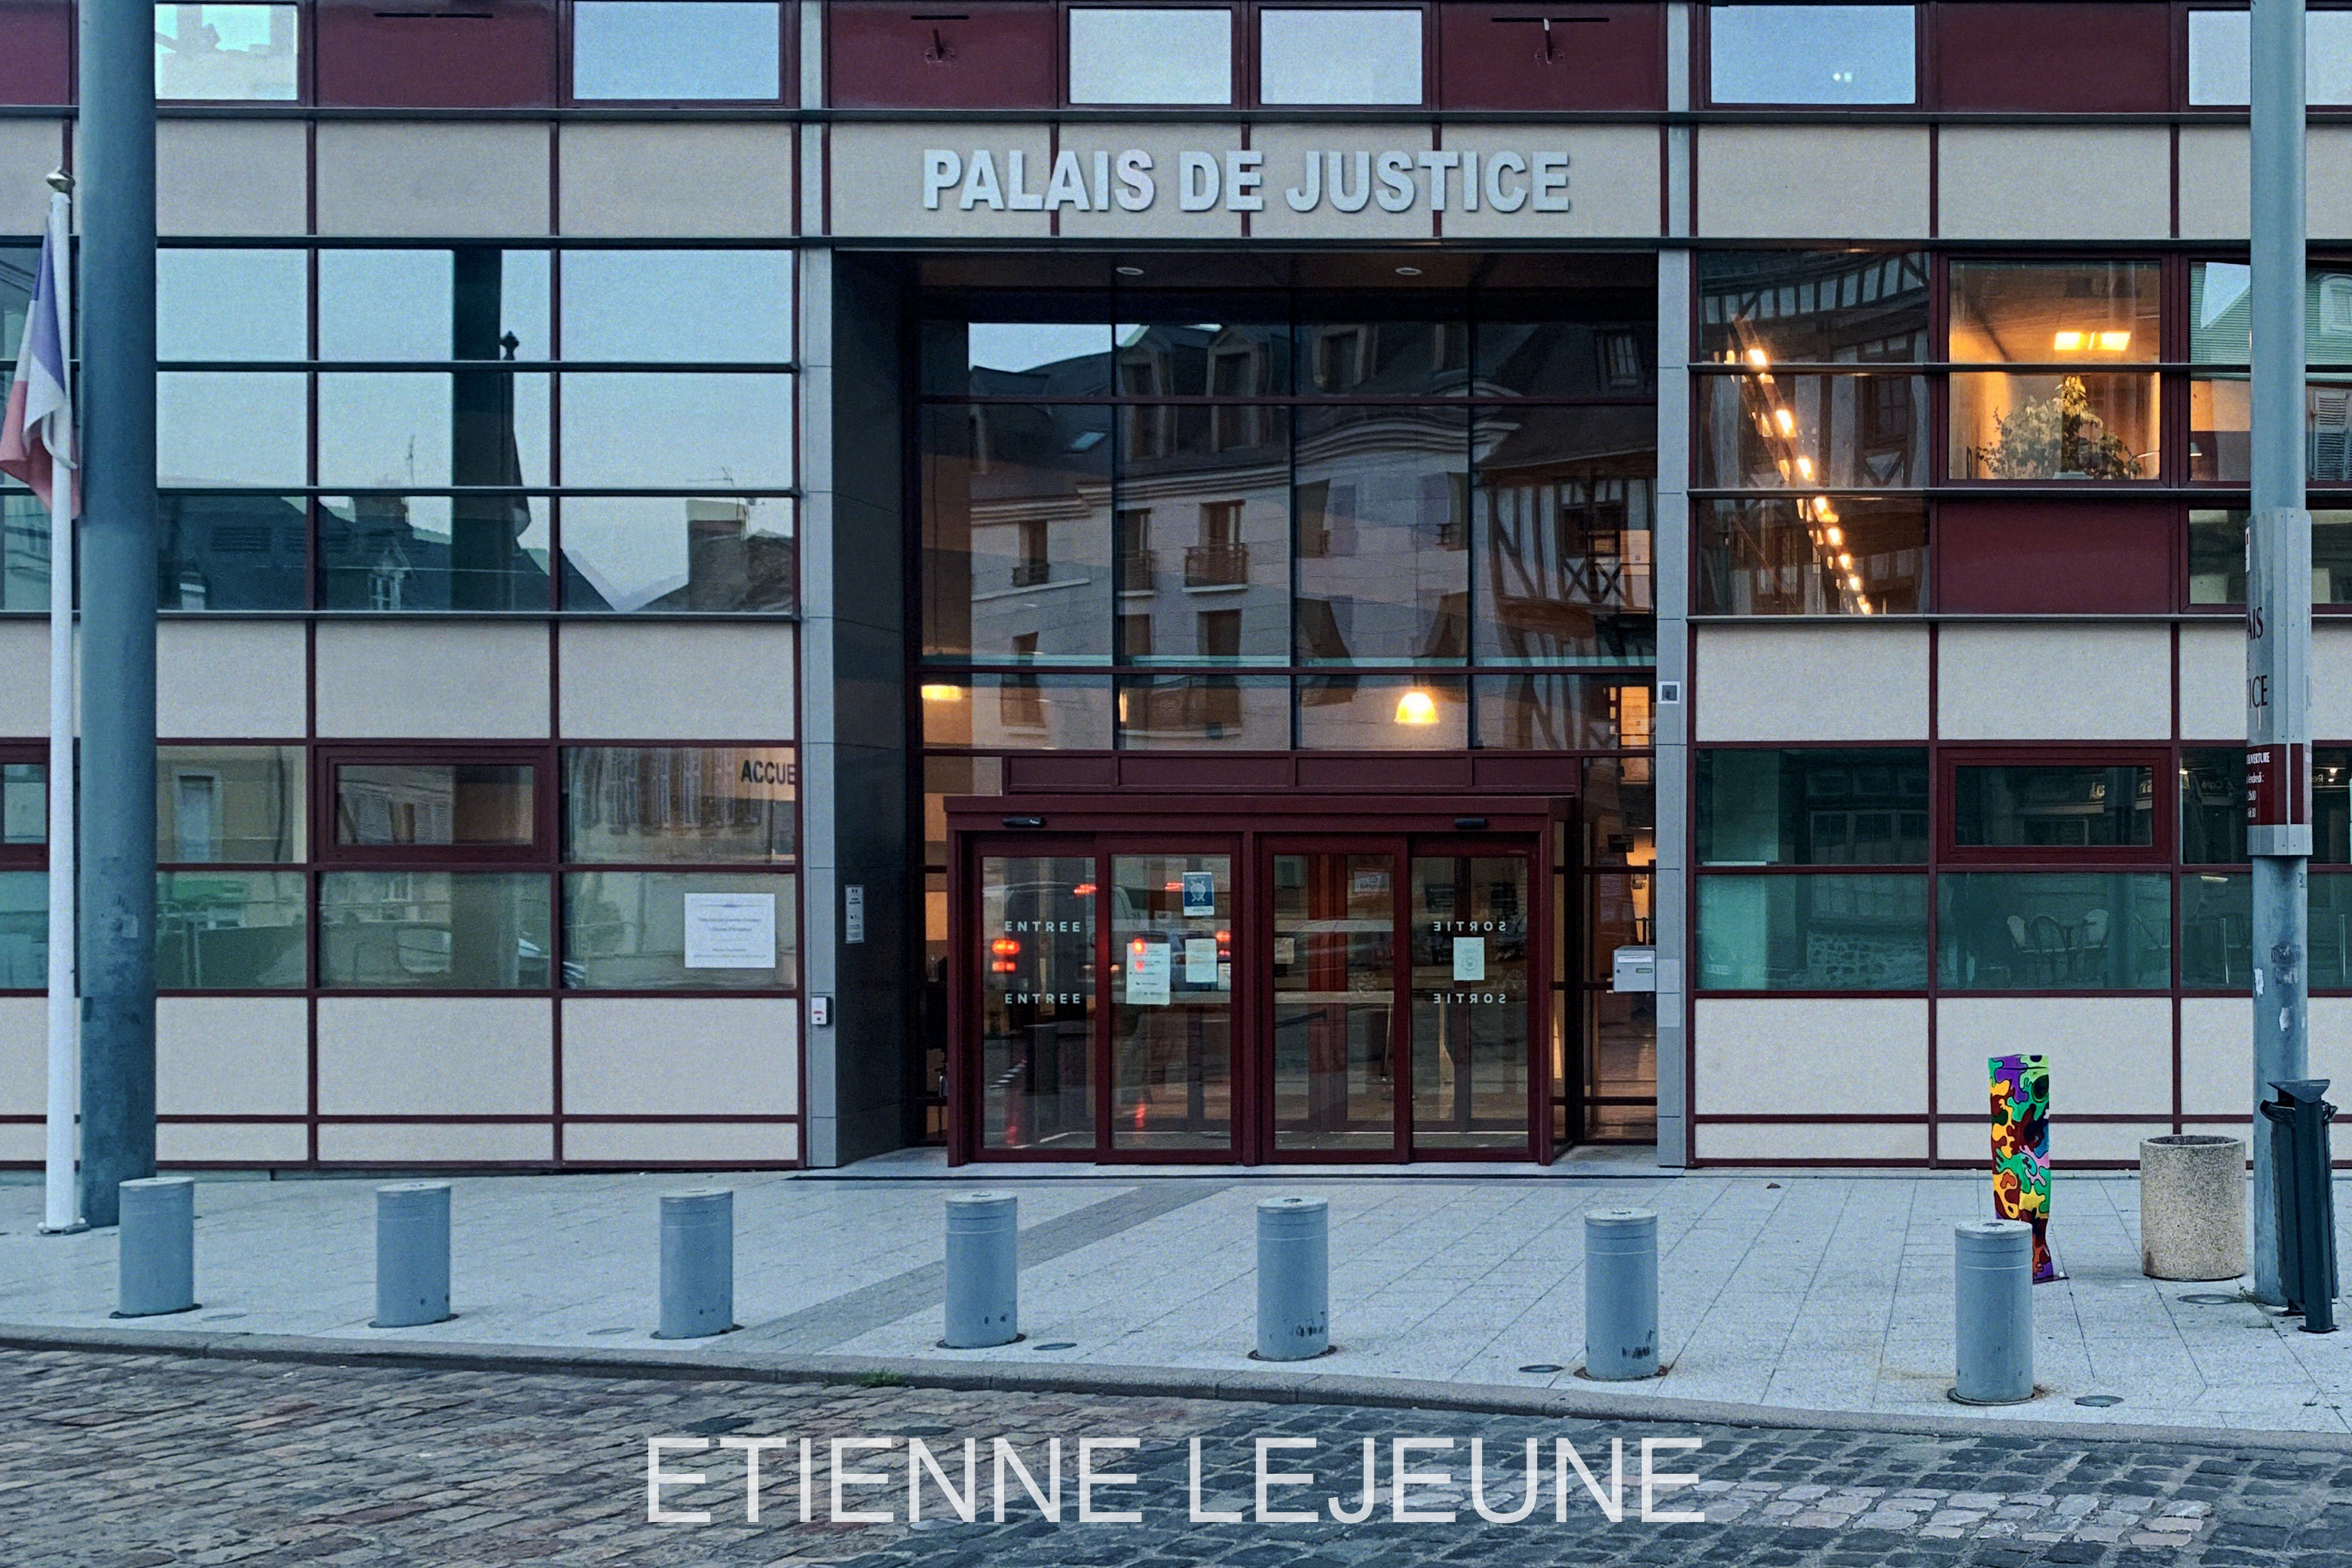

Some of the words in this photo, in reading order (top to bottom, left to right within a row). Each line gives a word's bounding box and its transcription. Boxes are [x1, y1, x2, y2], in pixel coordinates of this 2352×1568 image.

[923, 149, 1156, 212] PALAIS
[1180, 150, 1265, 212] DE
[1285, 149, 1570, 212] JUSTICE
[1004, 921, 1080, 933] ENTREE
[1004, 993, 1080, 1004] ENTREE
